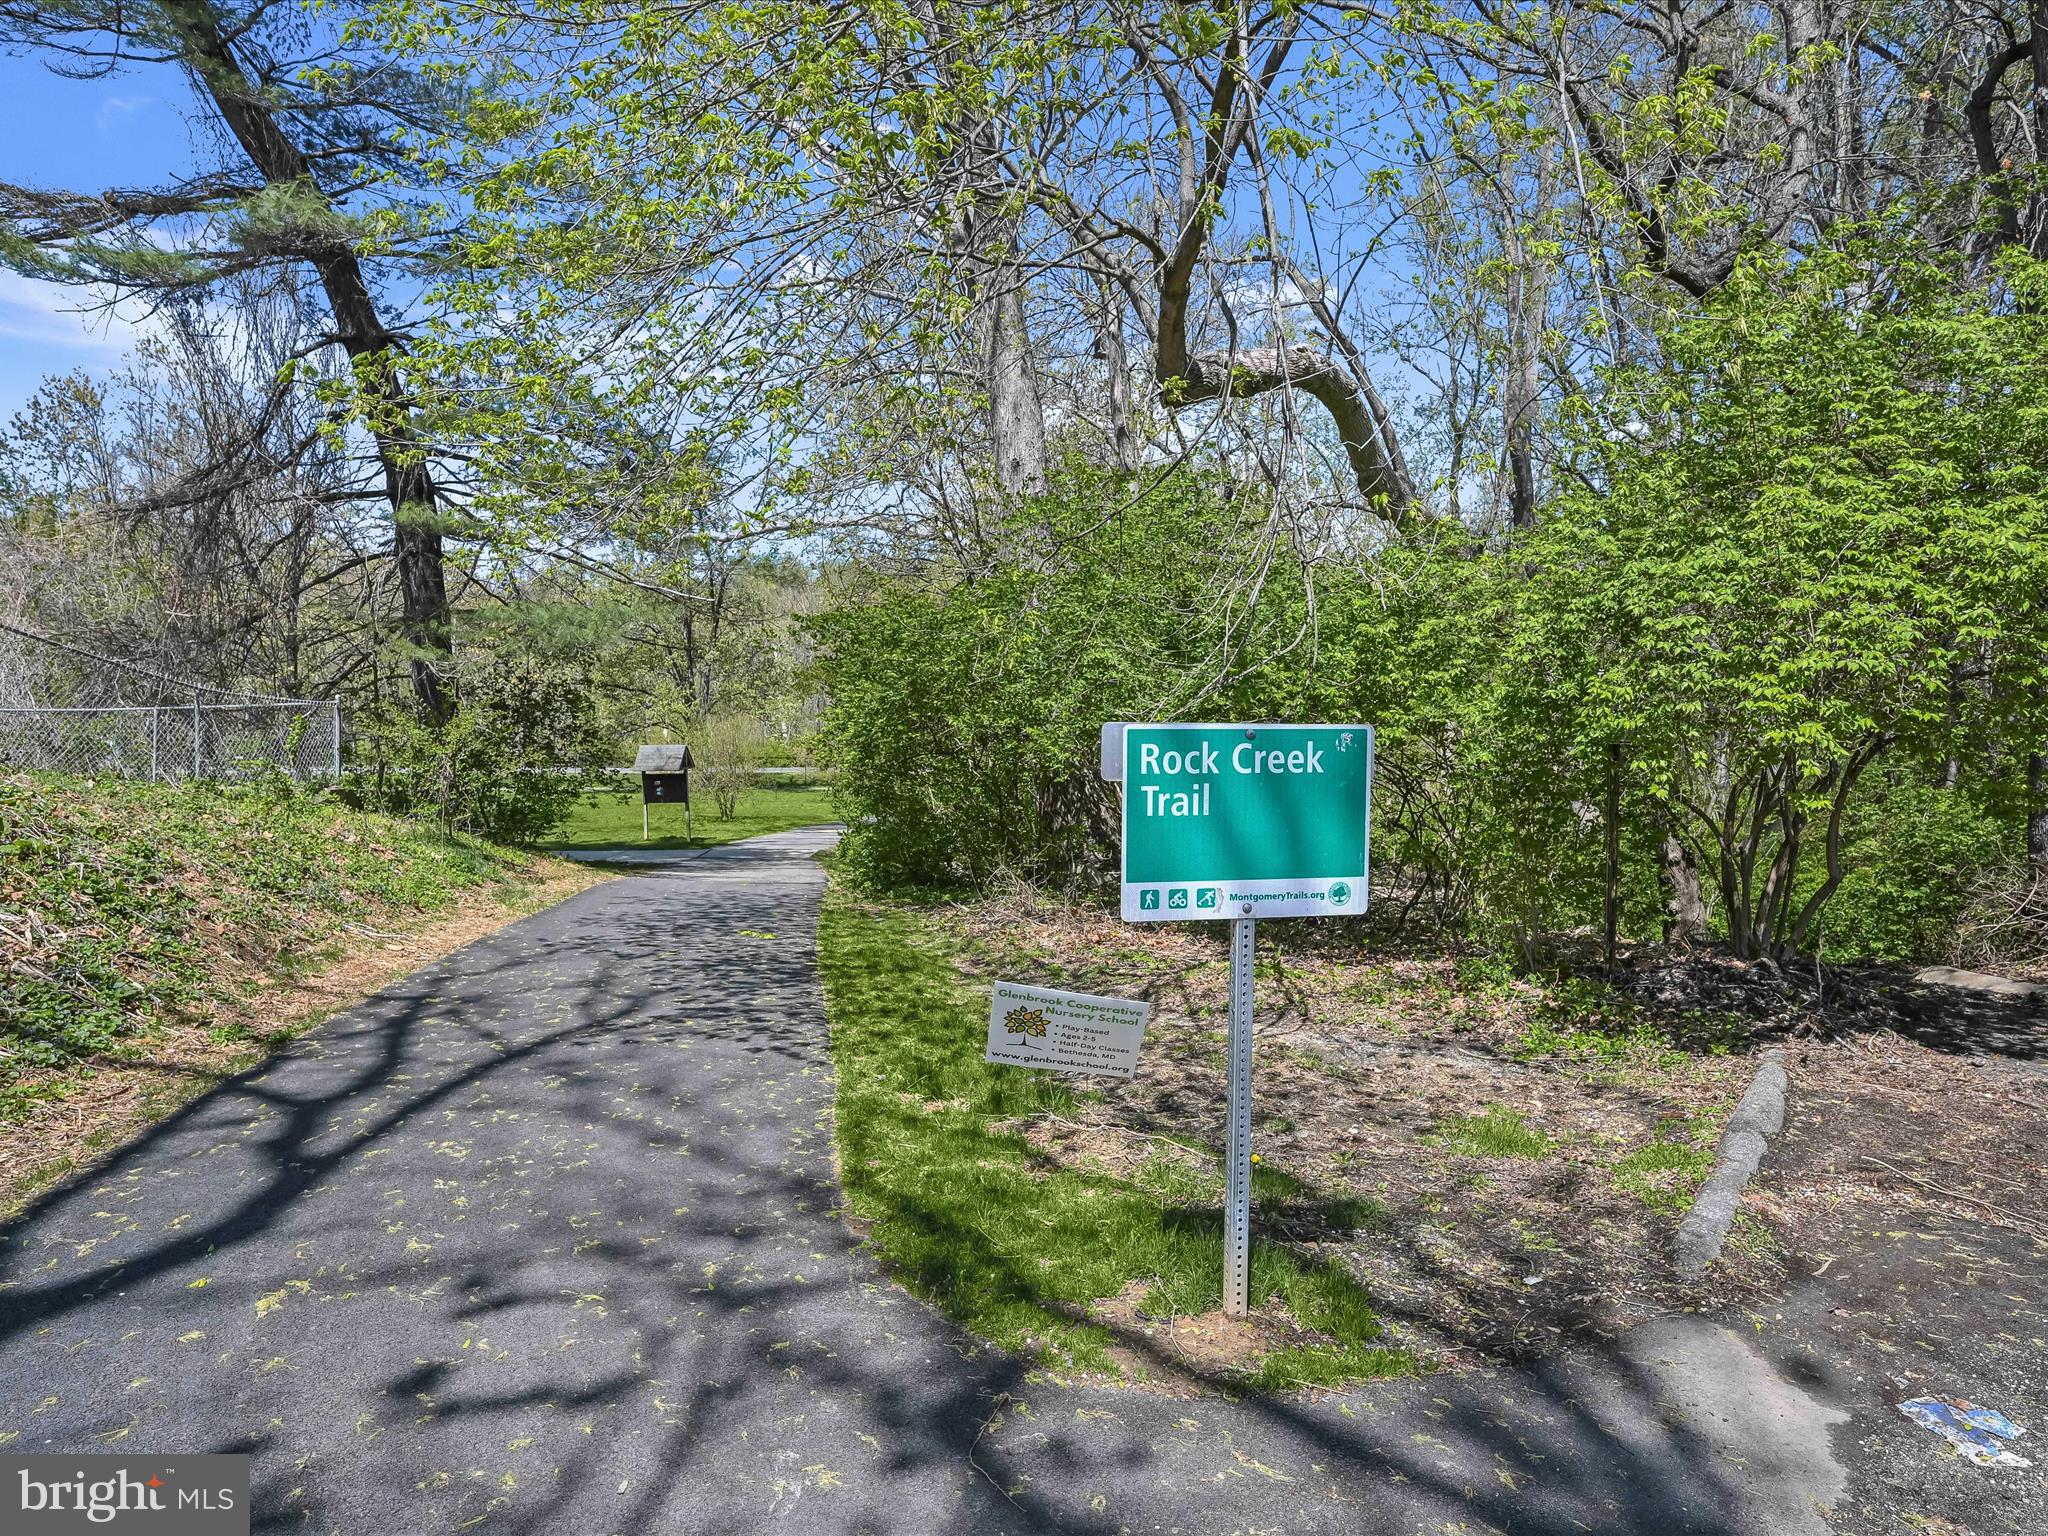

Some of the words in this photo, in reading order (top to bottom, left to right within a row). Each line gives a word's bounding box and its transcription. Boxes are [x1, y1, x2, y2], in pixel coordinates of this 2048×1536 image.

[1140, 740, 1220, 775] Rock
[1232, 740, 1325, 775] Creek
[1140, 783, 1210, 817] Trail
[1229, 890, 1325, 903] MontgomeryTrails.org
[998, 989, 1064, 1006] Glenbrook
[1067, 1000, 1144, 1017] Cooperative
[1045, 1006, 1095, 1021] Nursery
[1098, 1014, 1139, 1027] School
[1060, 1032, 1081, 1041] Ages
[1062, 1024, 1110, 1036] Play-Based
[1058, 1048, 1100, 1059] Bethesda,
[1059, 1040, 1097, 1051] Half-Day
[1098, 1045, 1130, 1054] Classes
[991, 1050, 1130, 1074] www.glenbrookschool.org
